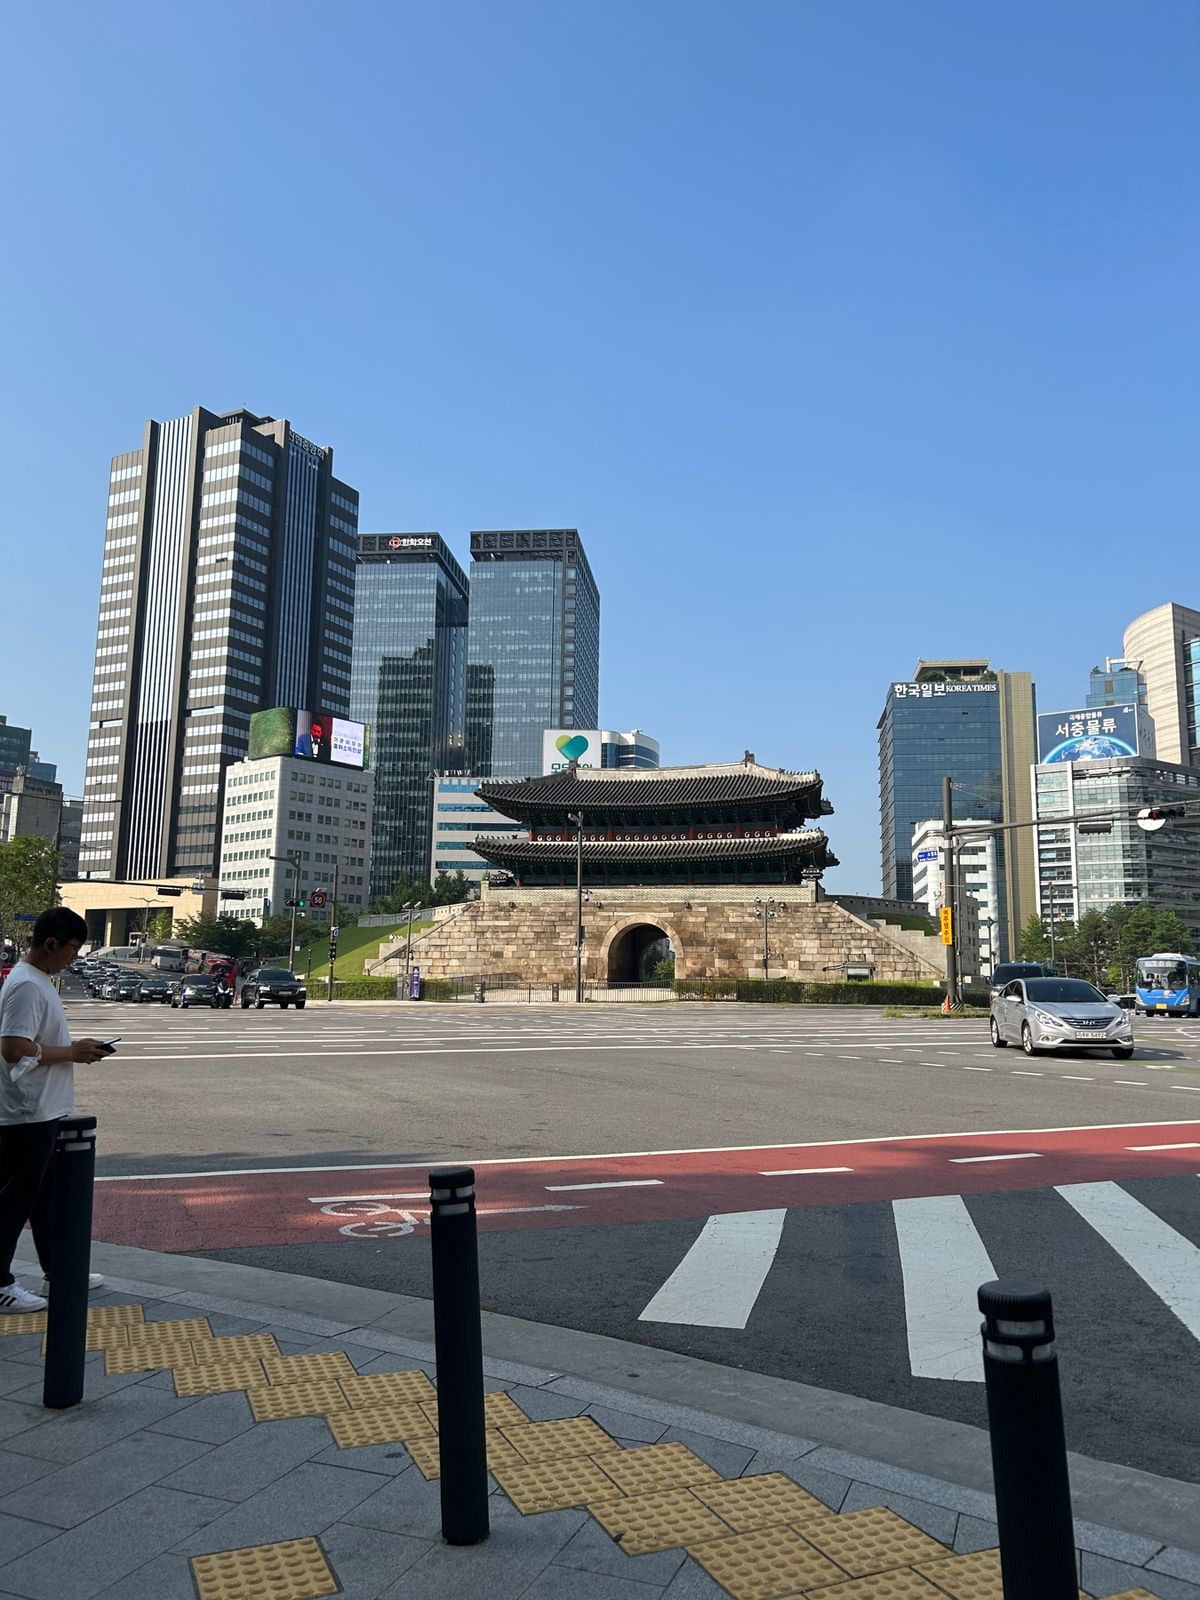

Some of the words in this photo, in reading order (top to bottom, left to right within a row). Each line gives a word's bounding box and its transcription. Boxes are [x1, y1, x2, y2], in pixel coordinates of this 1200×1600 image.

[894, 683, 946, 698] 한국일보
[972, 684, 997, 692] TIMES
[1055, 718, 1117, 738] 서중물류
[314, 896, 323, 904] 50
